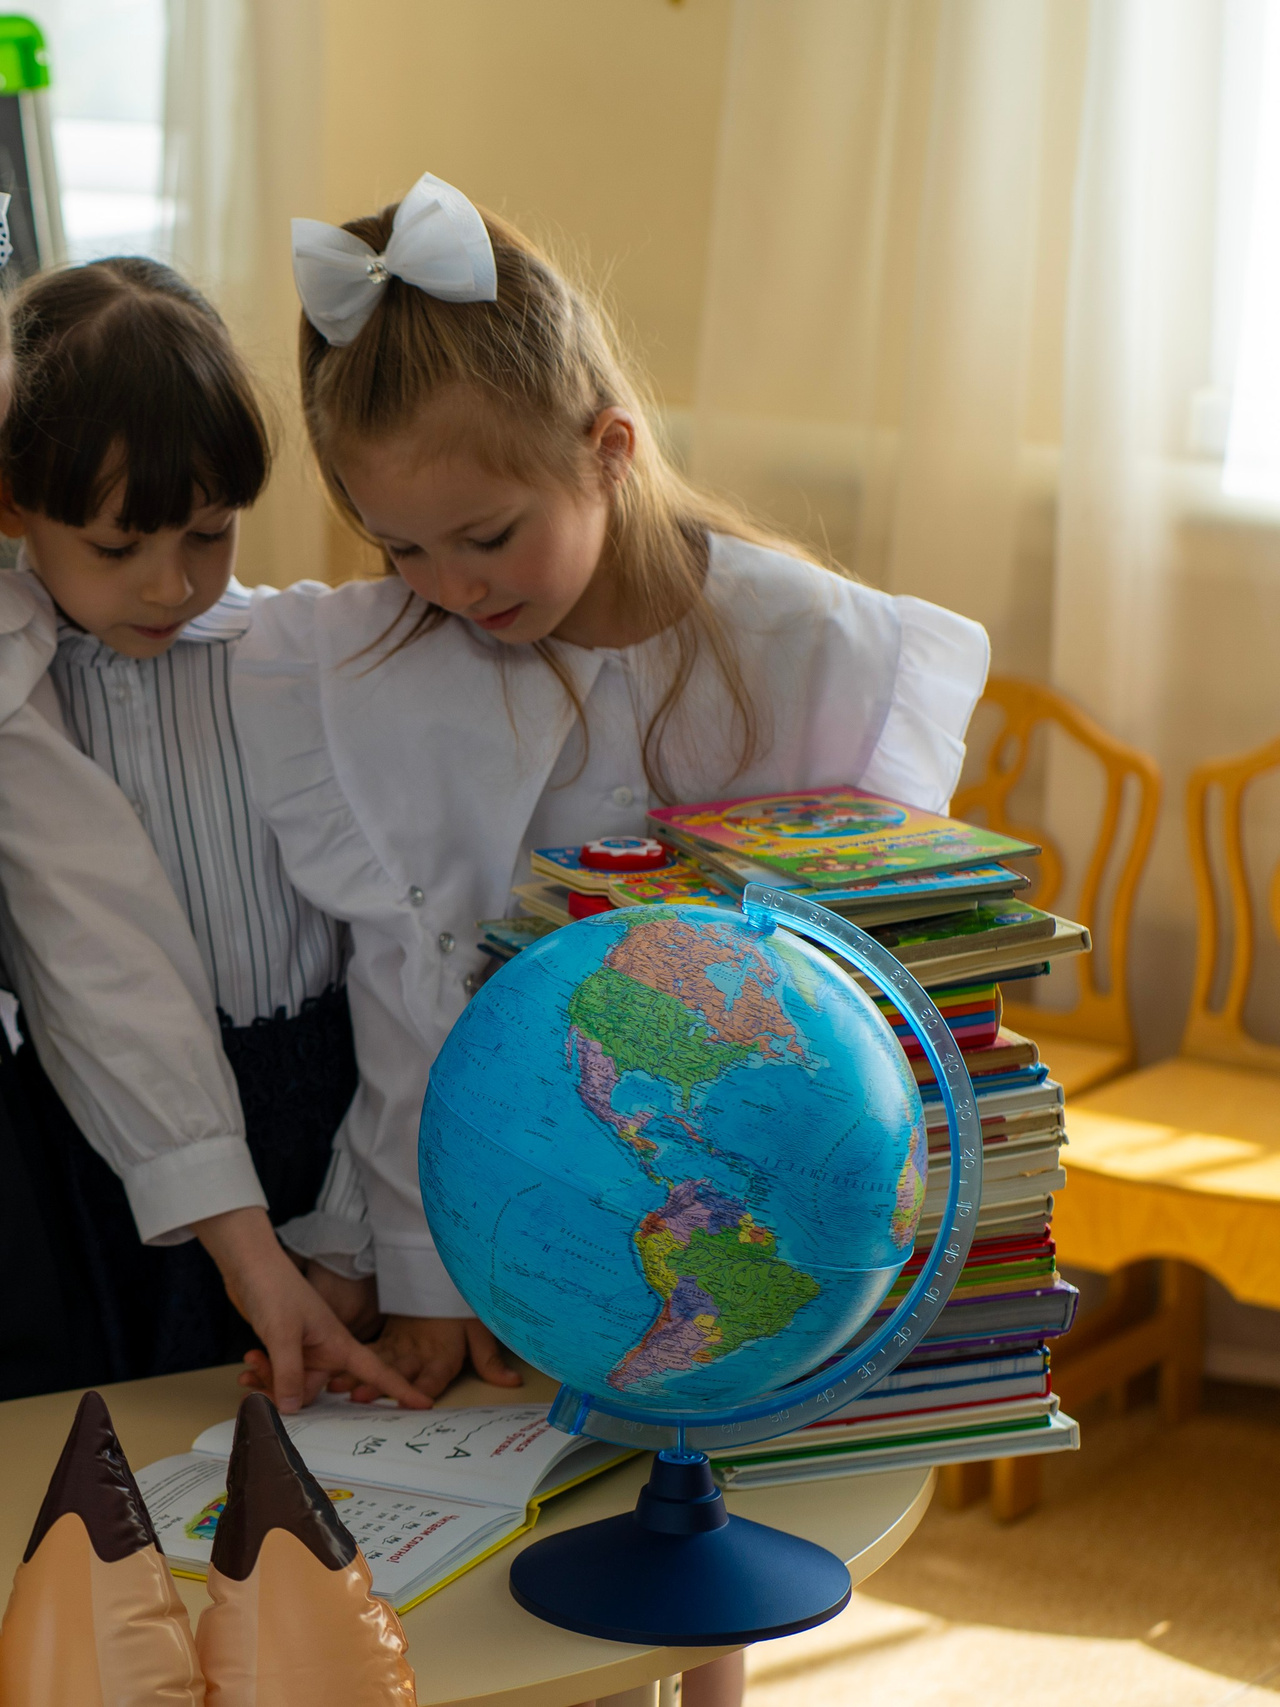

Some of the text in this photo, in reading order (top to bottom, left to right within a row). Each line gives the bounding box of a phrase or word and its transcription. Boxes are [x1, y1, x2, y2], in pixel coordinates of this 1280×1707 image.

[445, 1446, 471, 1459] А
[422, 1514, 460, 1537] Читаем
[386, 1536, 424, 1563] слитно!
